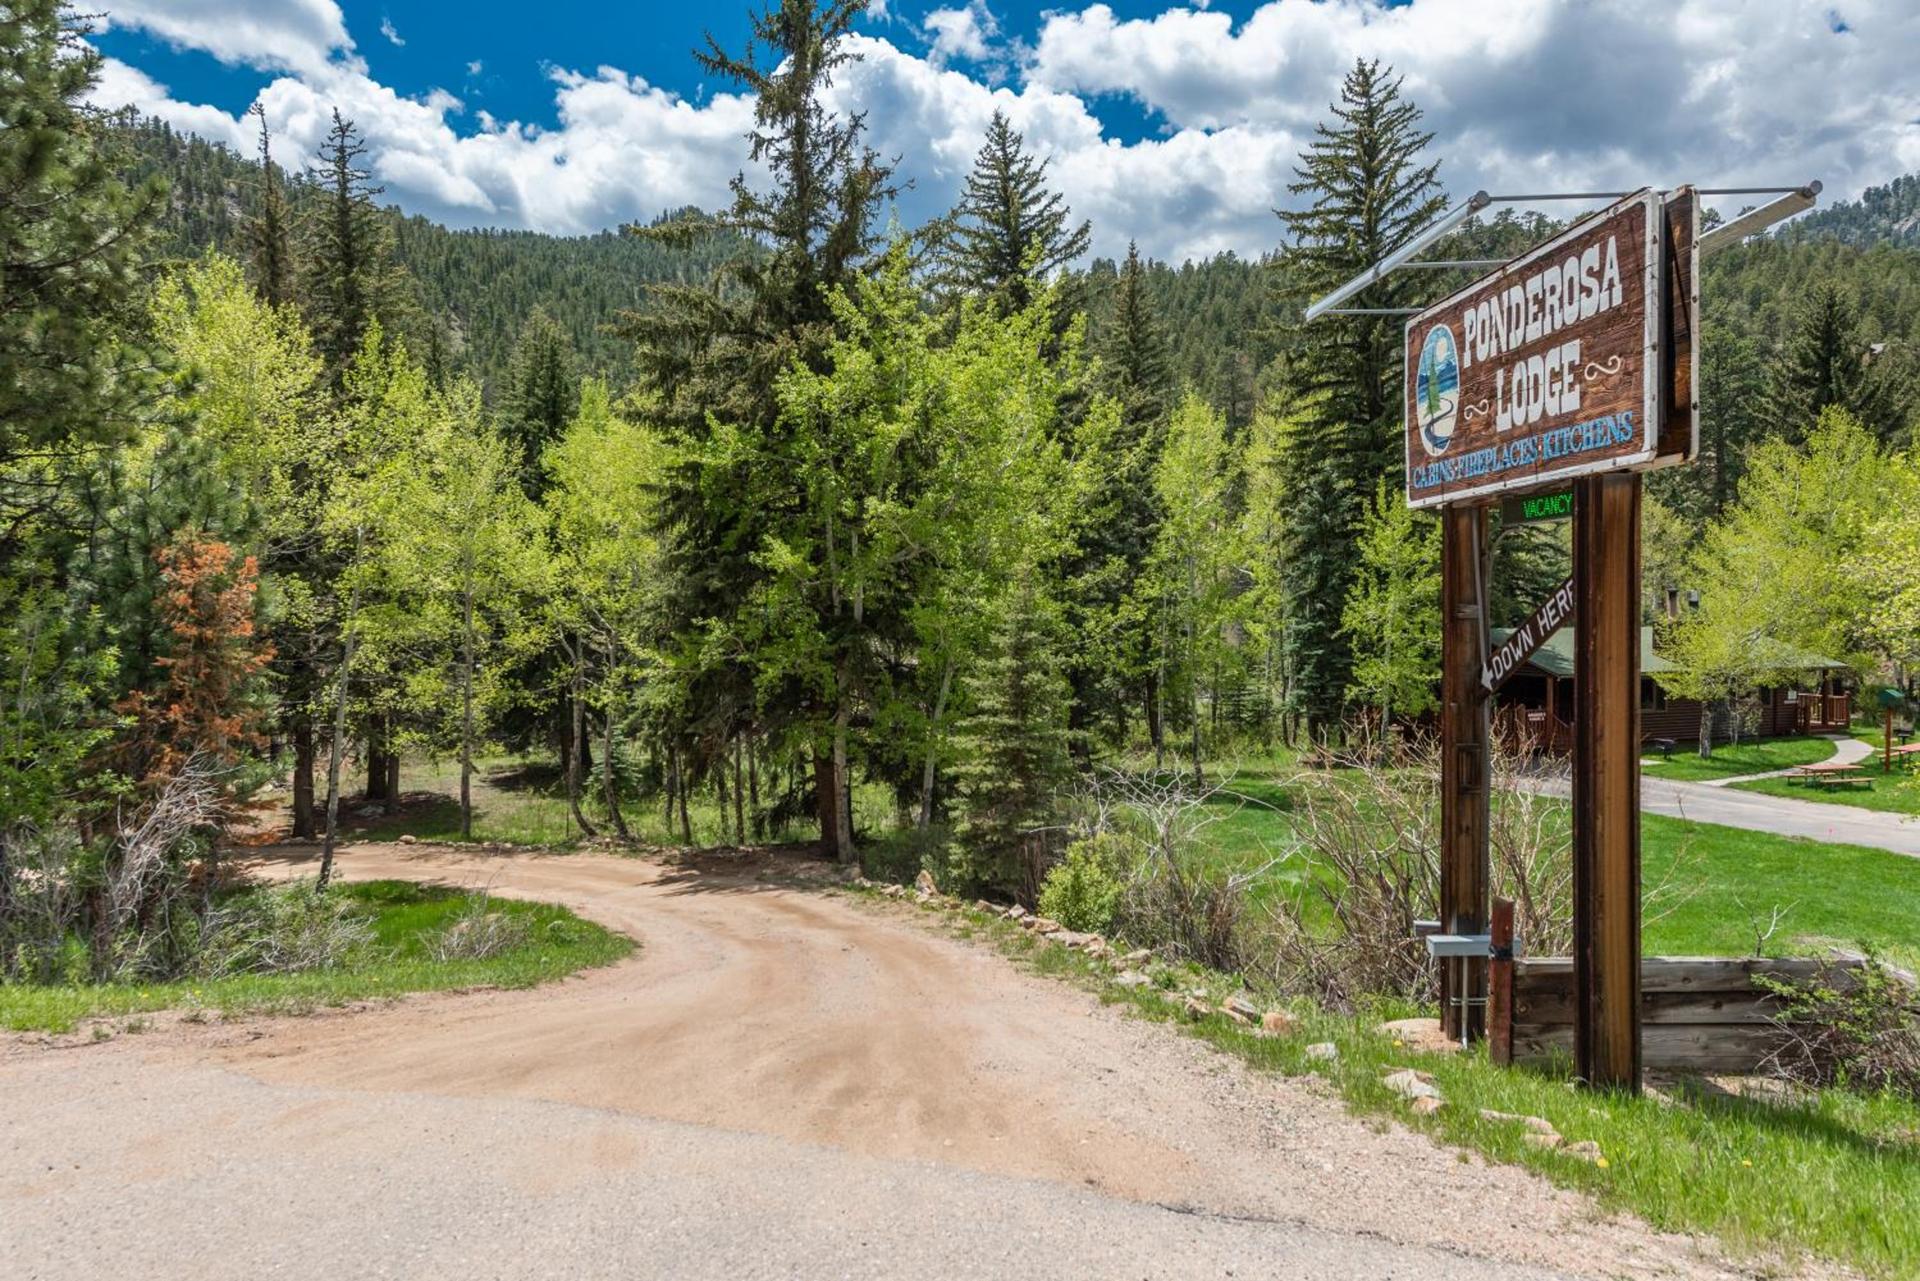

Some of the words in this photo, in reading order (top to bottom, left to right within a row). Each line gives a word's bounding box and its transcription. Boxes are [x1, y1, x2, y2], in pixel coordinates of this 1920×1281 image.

[1463, 235, 1623, 368] PONDEROSA
[1496, 338, 1581, 433] LODGE
[1542, 410, 1634, 460] KITCHENS
[1523, 493, 1573, 518] VACANCY
[1491, 623, 1535, 681] DOWN
